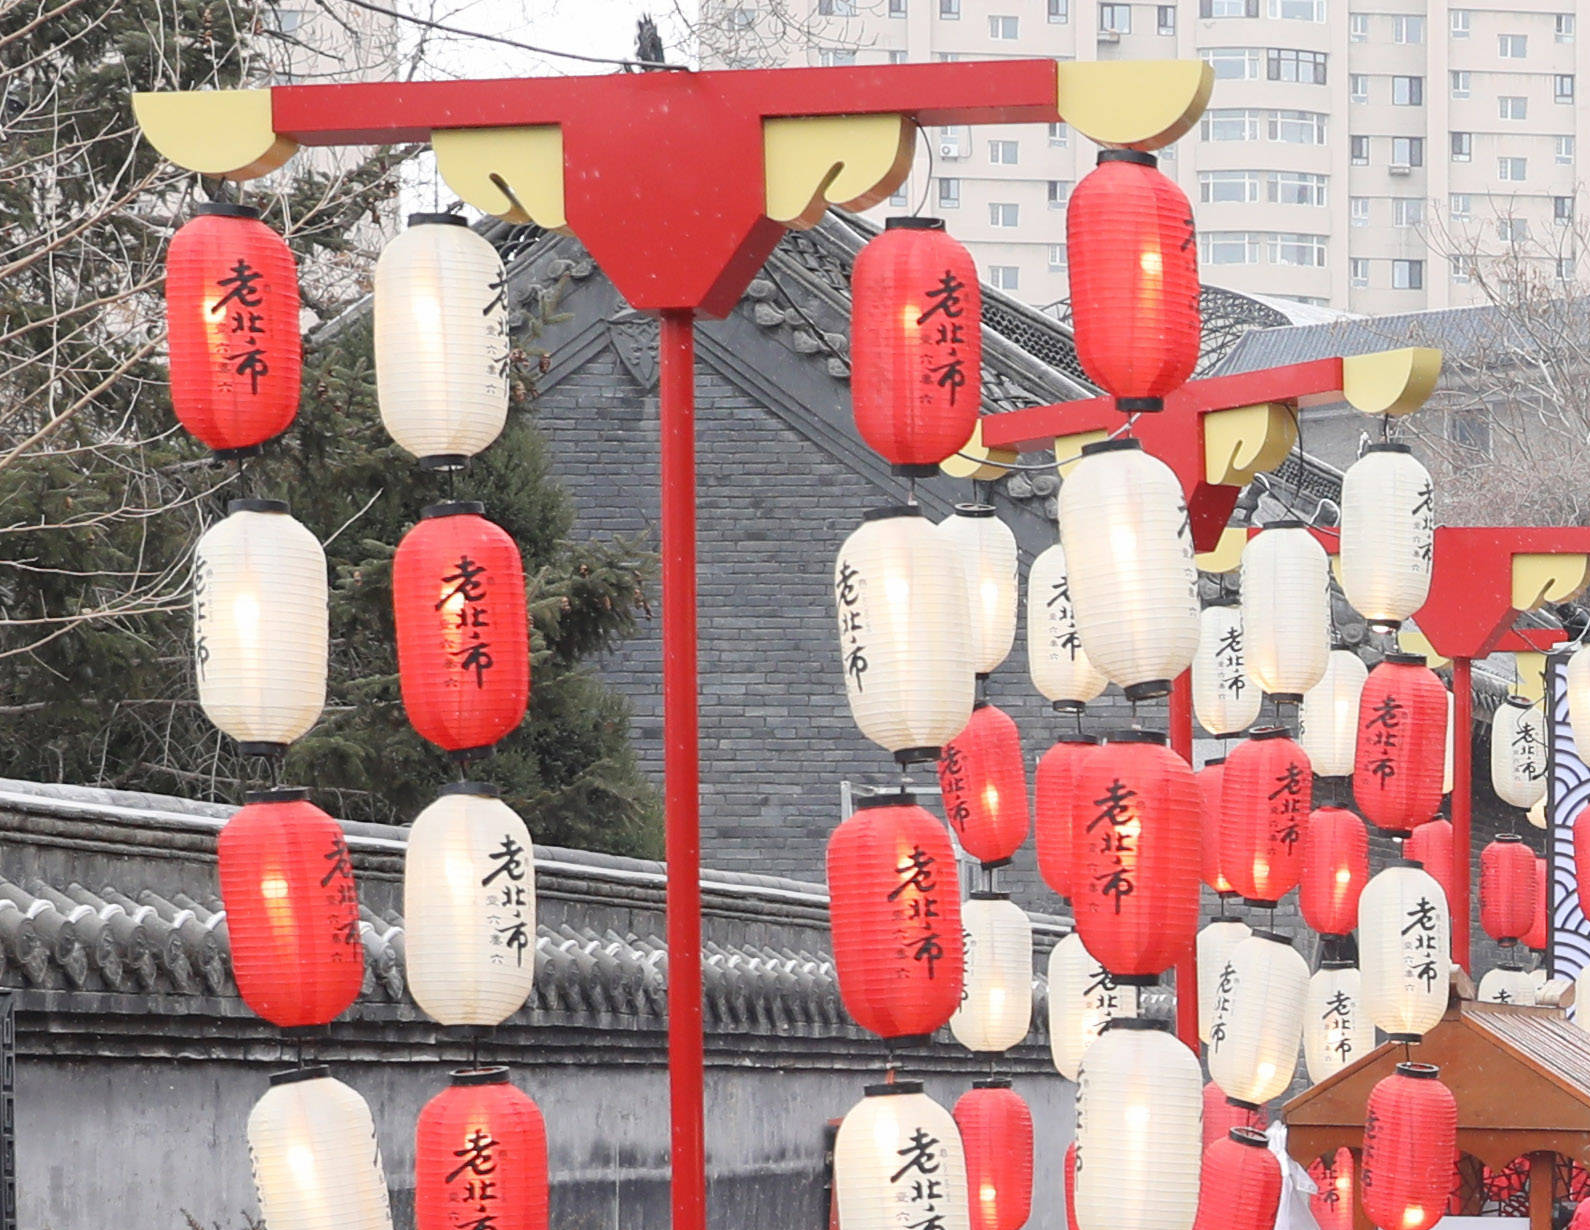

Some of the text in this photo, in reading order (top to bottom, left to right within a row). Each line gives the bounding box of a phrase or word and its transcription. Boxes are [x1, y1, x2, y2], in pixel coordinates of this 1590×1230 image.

[211, 258, 270, 396] 老北市
[917, 271, 968, 408] 老北市
[434, 555, 496, 690] 老北市
[1218, 626, 1247, 700] 老北市
[940, 741, 971, 834] 老北市
[1365, 694, 1404, 792] 老北市
[1515, 721, 1542, 783] 老北市
[1086, 779, 1143, 916] 老北市
[1269, 762, 1304, 858] 老北市
[481, 834, 528, 968] 老北市
[888, 845, 944, 982] 老北市
[1401, 898, 1438, 996] 老北市
[1209, 961, 1237, 1057] 老北市
[1322, 990, 1354, 1064] 老北市
